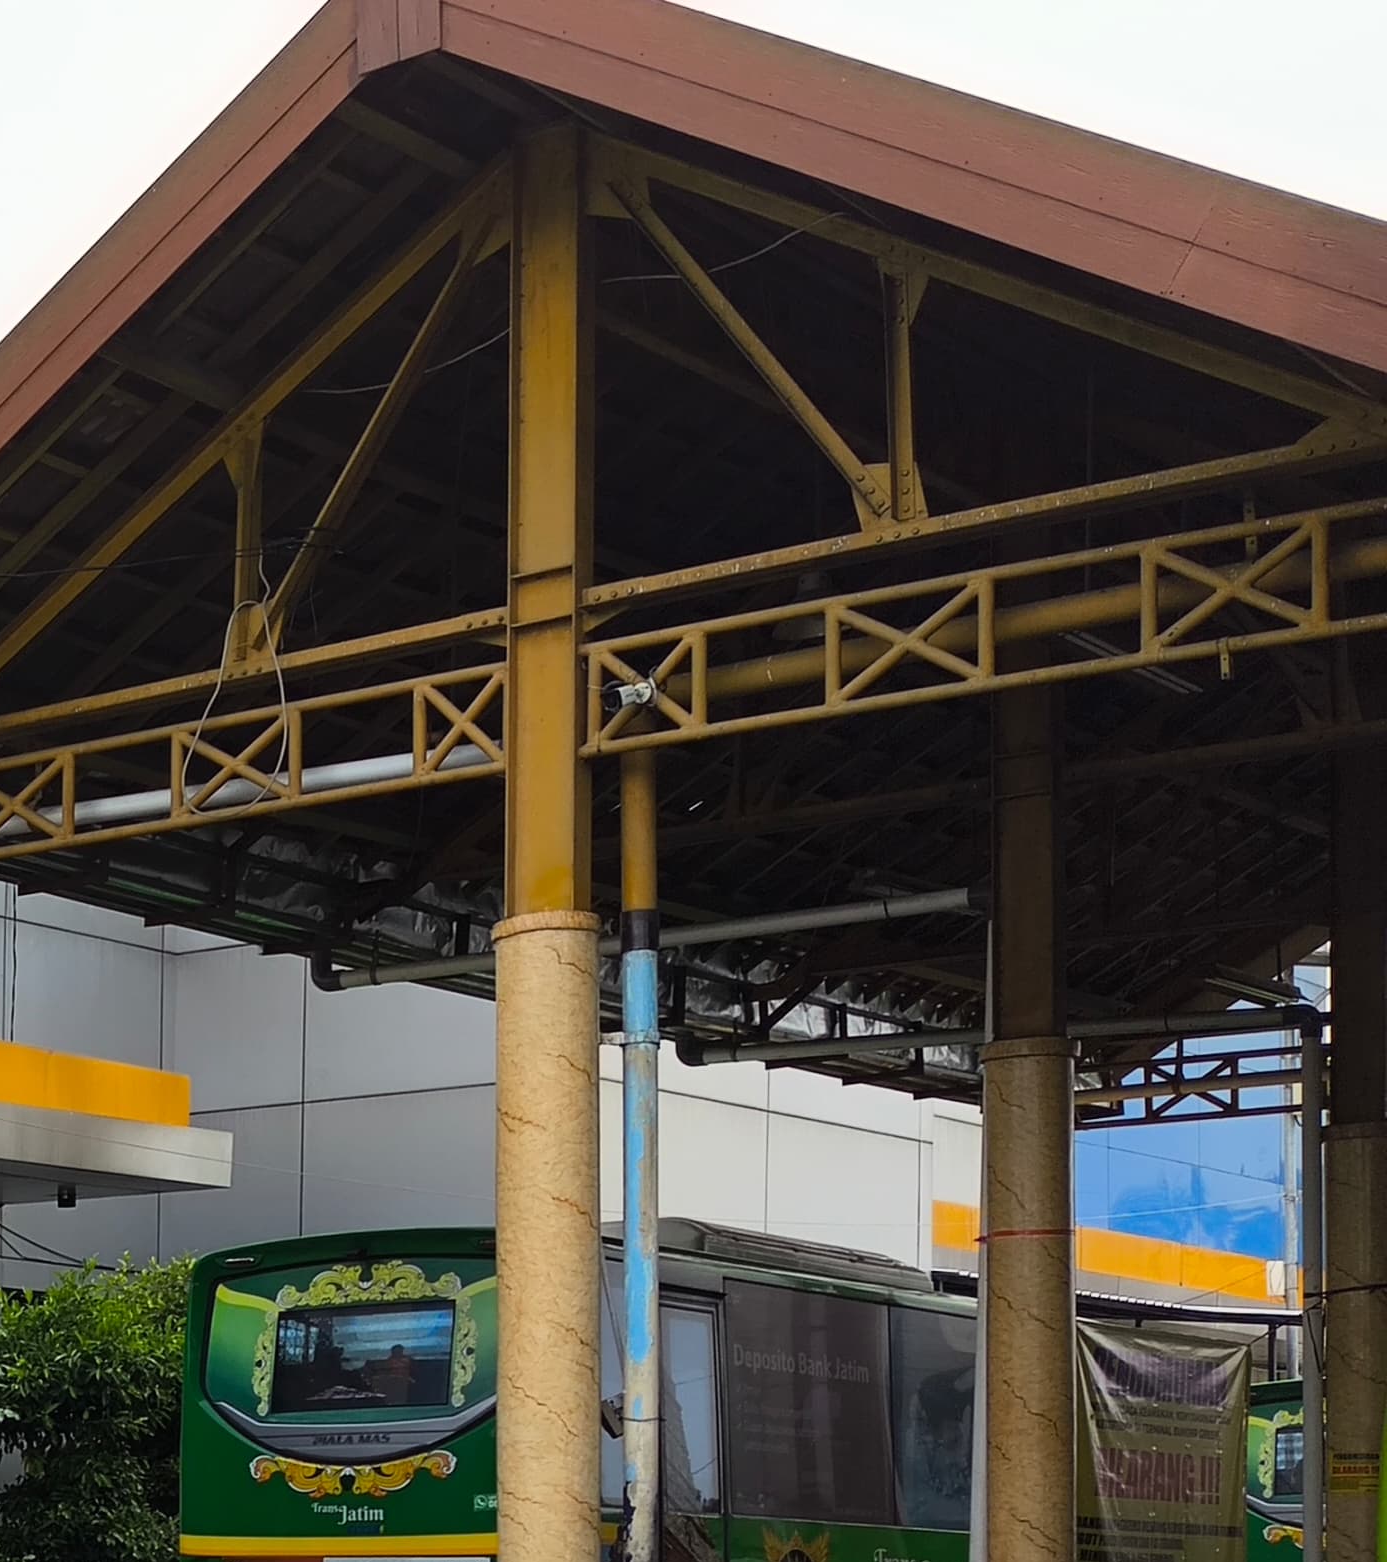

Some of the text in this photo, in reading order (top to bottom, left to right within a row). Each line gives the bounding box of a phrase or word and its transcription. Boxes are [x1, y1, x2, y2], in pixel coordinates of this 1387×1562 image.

[733, 1344, 870, 1384] Deposito Bank Jatim
[337, 1503, 384, 1525] Jatim
